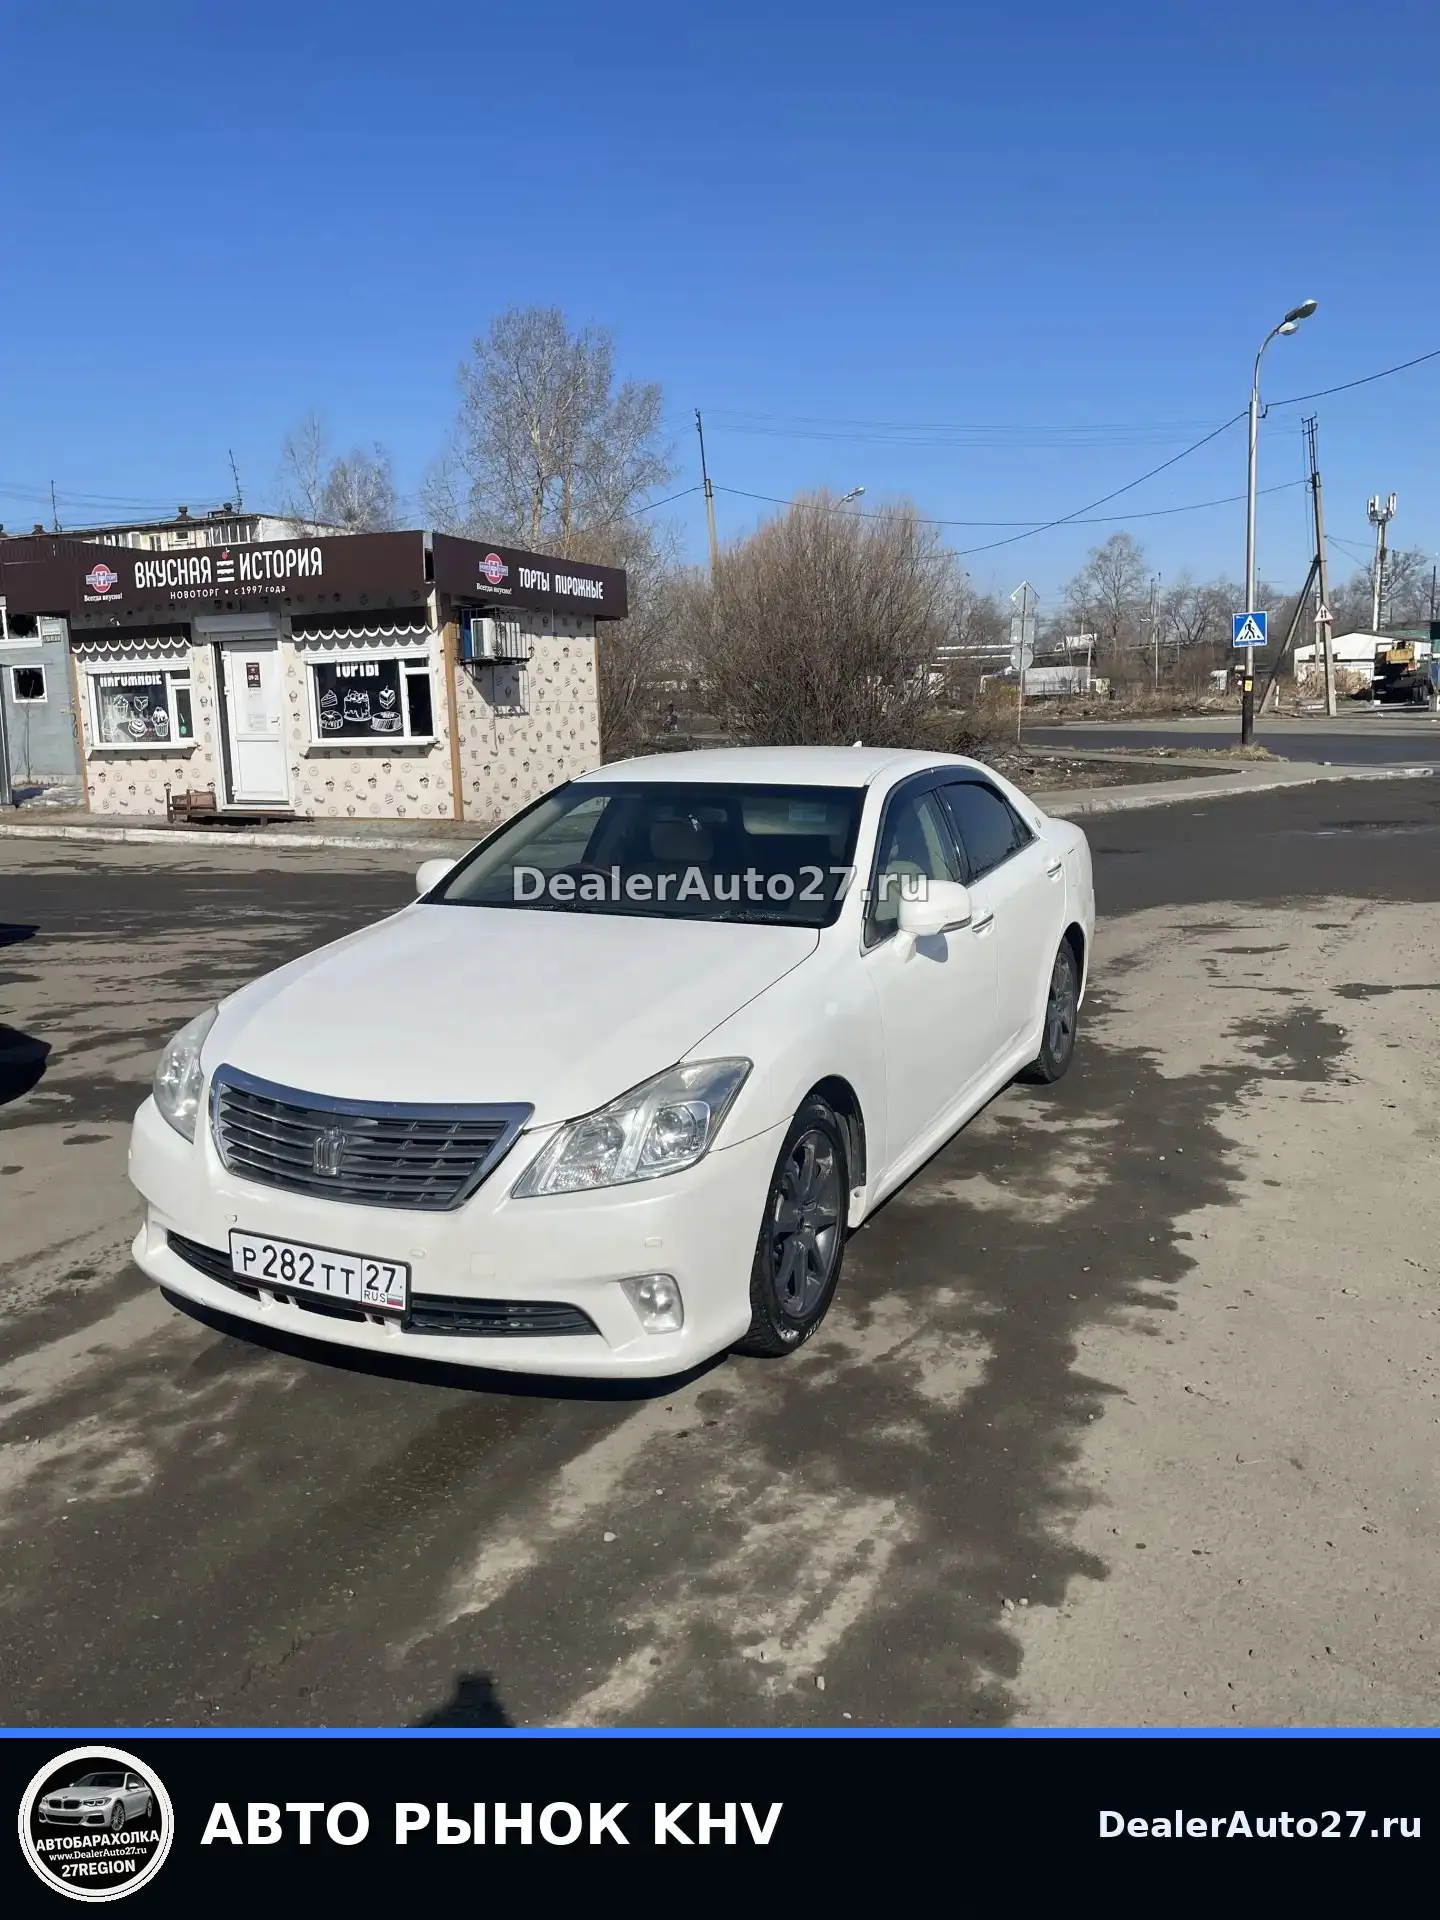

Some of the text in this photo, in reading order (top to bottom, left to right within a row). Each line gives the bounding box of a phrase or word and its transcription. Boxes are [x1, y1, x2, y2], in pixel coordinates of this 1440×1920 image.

[134, 547, 323, 588] ВКУСНАЯ ИСТОРИЯ
[170, 588, 220, 599] НОВОТОРГ
[241, 585, 263, 595] 1997
[265, 584, 286, 594] года
[519, 567, 604, 599] ТОРТЫ ПИРОЖНЫЕ
[366, 1263, 396, 1293] 27
[363, 1289, 386, 1303] RUS
